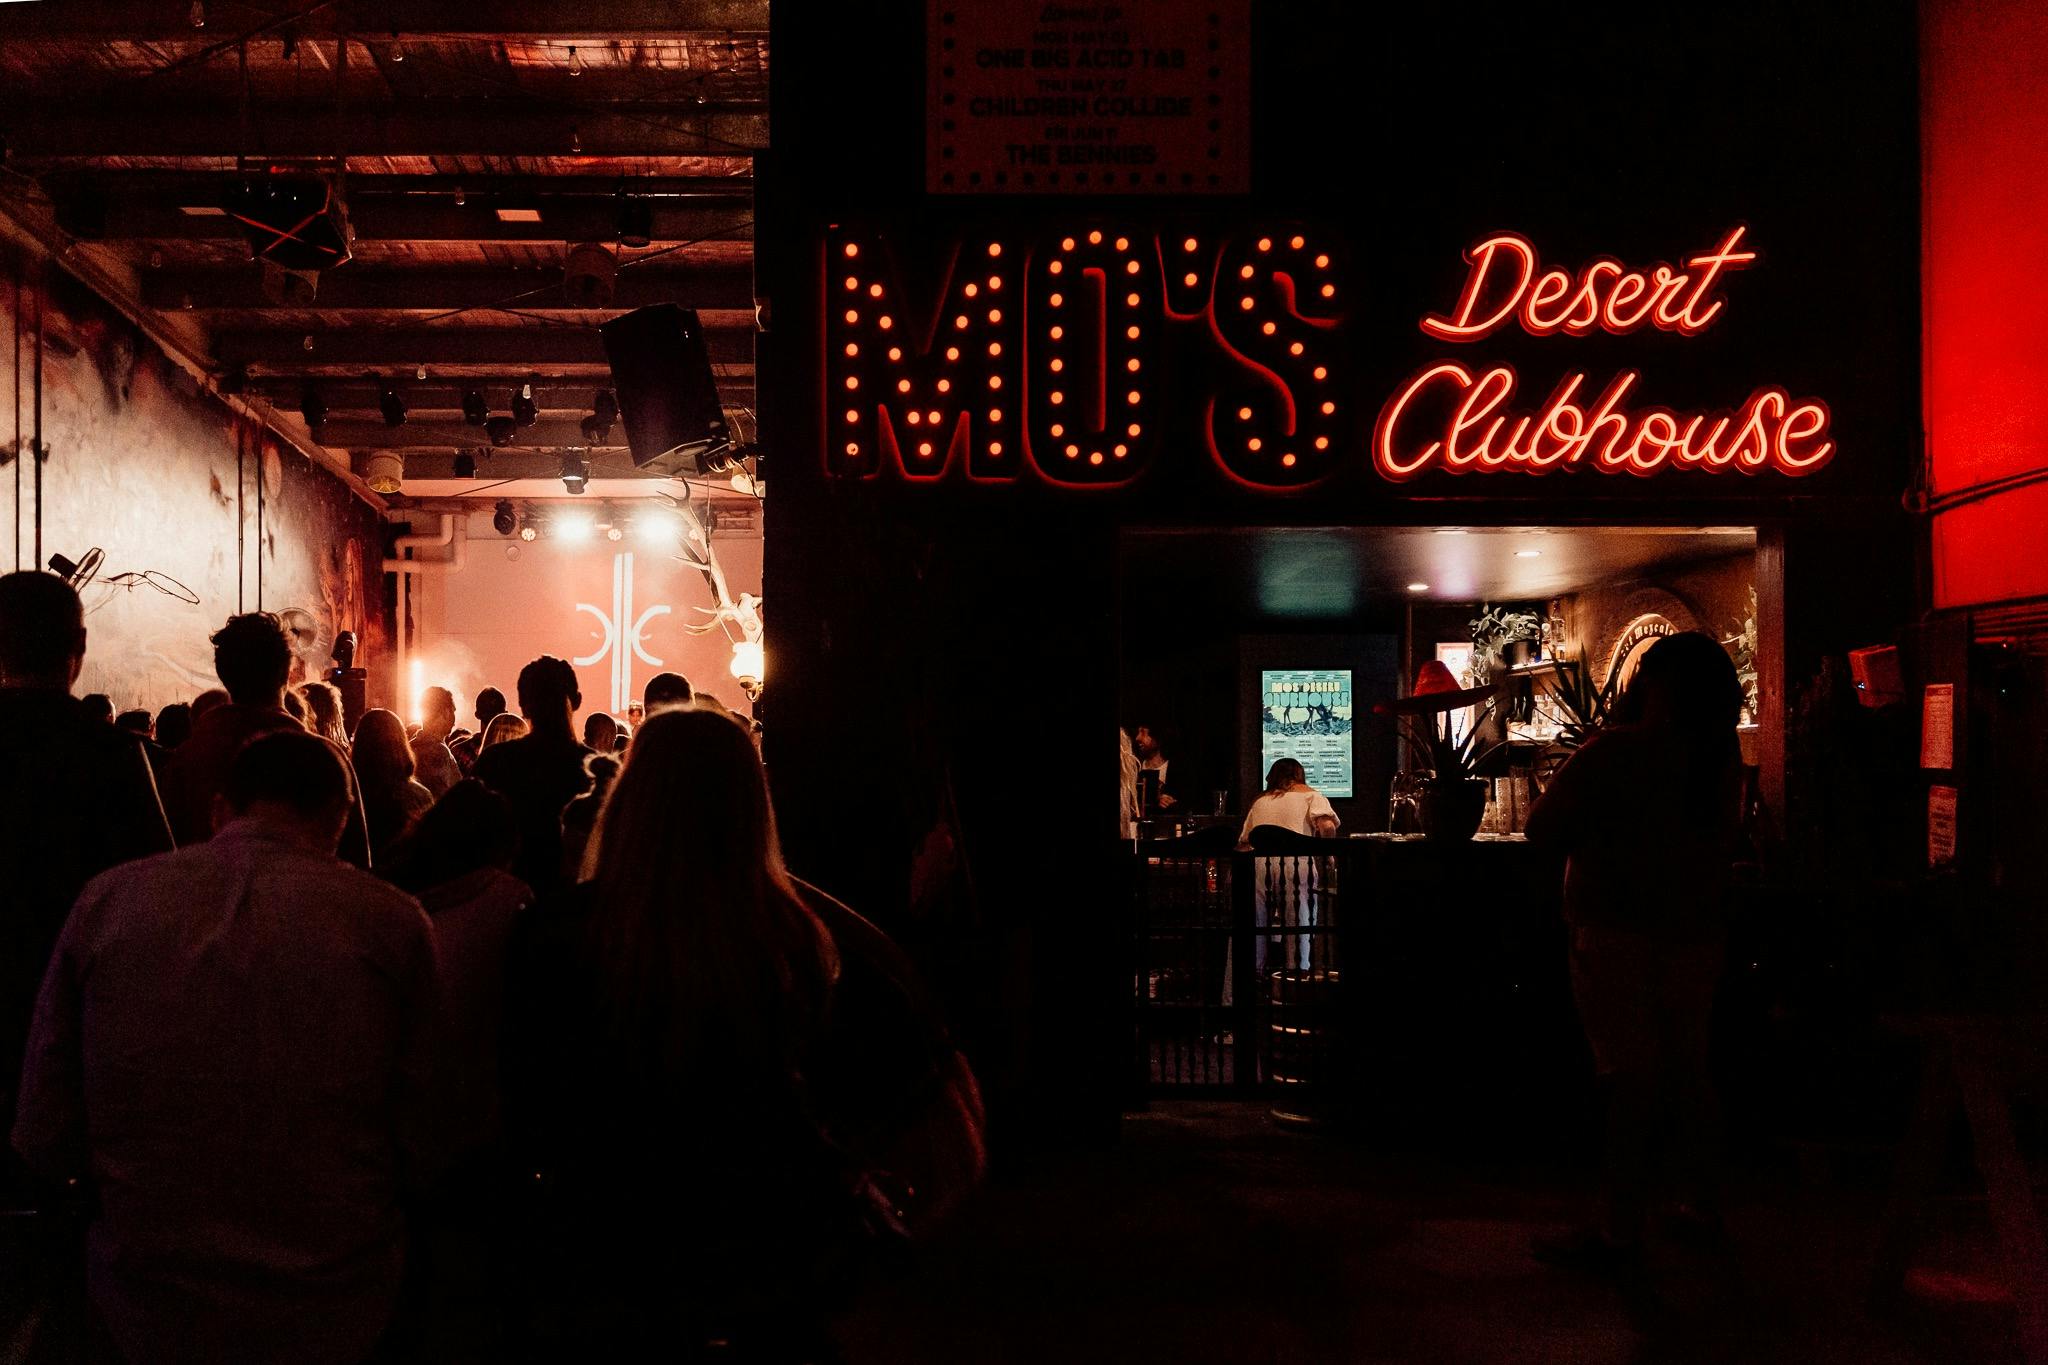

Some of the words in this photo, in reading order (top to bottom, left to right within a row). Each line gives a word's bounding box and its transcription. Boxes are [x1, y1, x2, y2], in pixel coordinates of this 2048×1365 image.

[976, 47, 1026, 69] ONE
[1031, 47, 1070, 69] BIG
[1077, 47, 1134, 69] ACID
[1139, 47, 1185, 69] TAB
[969, 96, 1087, 117] CHILDREN
[1093, 96, 1192, 117] COLLIDE
[1004, 143, 1051, 165] THE
[1056, 143, 1158, 165] BENNIES
[1422, 224, 1757, 338] Desert
[821, 223, 1342, 490] MO'S
[1379, 362, 1833, 476] Clubhouse
